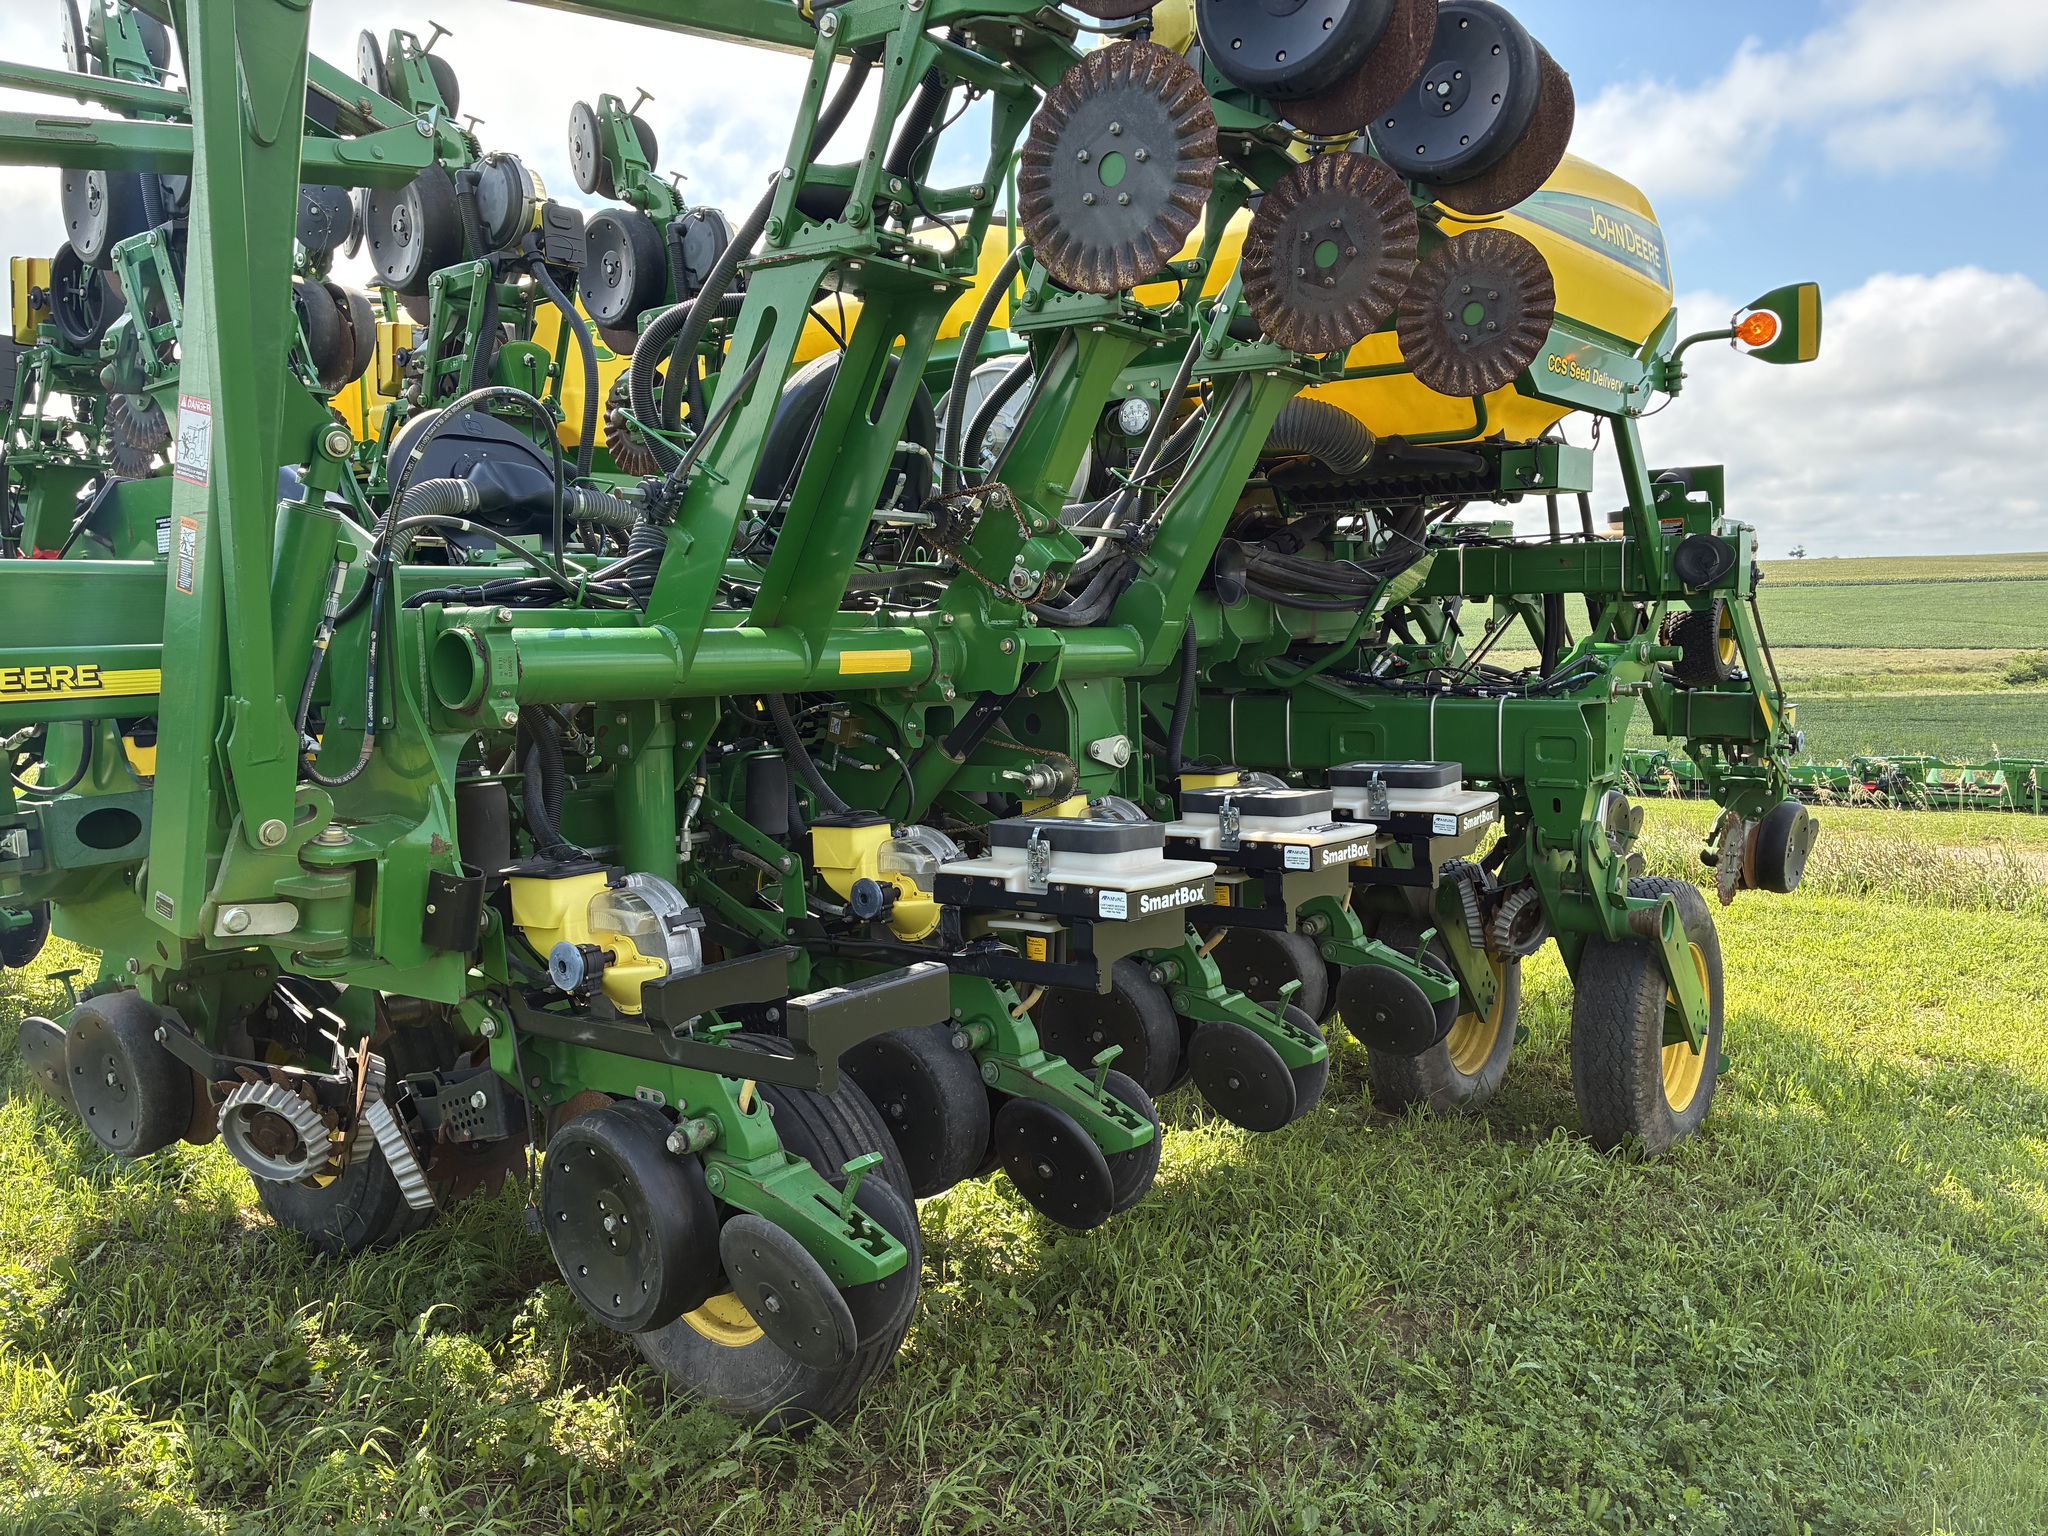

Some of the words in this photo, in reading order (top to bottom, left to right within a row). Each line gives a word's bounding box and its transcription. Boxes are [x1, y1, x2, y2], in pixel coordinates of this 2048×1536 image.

[1624, 223, 1661, 269] DEERE
[1547, 354, 1568, 376] CCS
[1569, 361, 1591, 382] Seed
[1592, 368, 1623, 396] Delivery
[187, 398, 211, 413] DANGER
[1463, 809, 1494, 830] SmartBox
[1322, 843, 1369, 865] SmartBox
[1140, 886, 1205, 913] SmartBox
